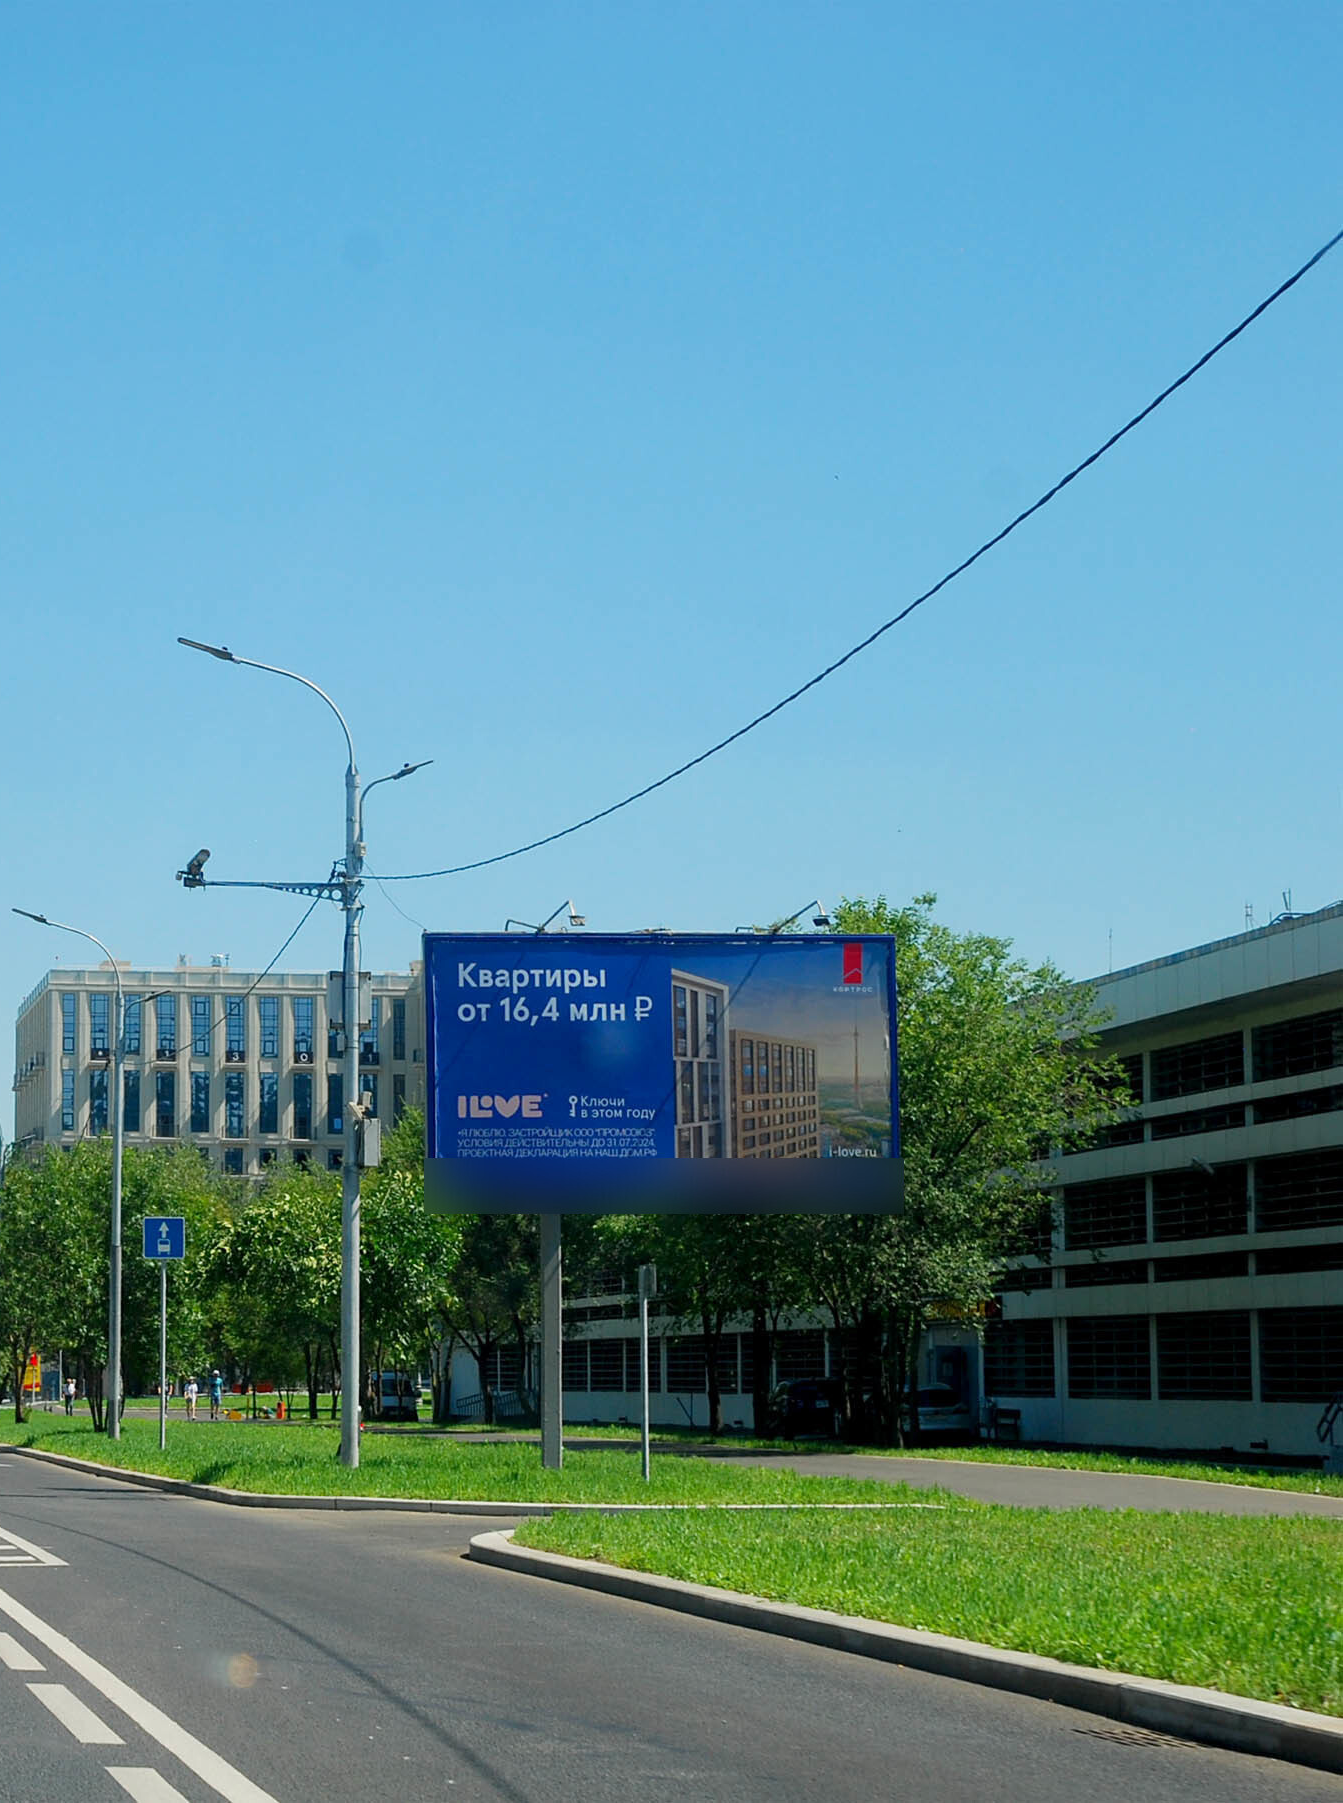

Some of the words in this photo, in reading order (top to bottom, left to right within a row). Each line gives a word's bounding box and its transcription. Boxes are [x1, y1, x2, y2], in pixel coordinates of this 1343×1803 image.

[457, 962, 606, 994] Квартиры
[457, 1003, 491, 1022] от
[500, 996, 560, 1027] 16,4
[569, 1003, 626, 1022] млн
[634, 996, 653, 1022] ₽
[580, 1095, 625, 1107] Ключи
[580, 1108, 588, 1118] в
[591, 1108, 623, 1118] этом
[626, 1108, 656, 1120] году
[508, 1127, 574, 1138] ЗАСТРОЙЩИК
[574, 1128, 595, 1137] ООО
[457, 1138, 504, 1148] УСЛОВИЯ
[504, 1138, 590, 1148] ДЕЙСТВИТЕЛЬНЫ
[591, 1138, 606, 1148] ДО
[457, 1149, 514, 1158] ПРОЕКТНАЯ
[514, 1149, 580, 1158] ДЕКЛАРАЦИЯ
[580, 1149, 594, 1158] НА
[829, 1145, 877, 1158] i-love.ru
